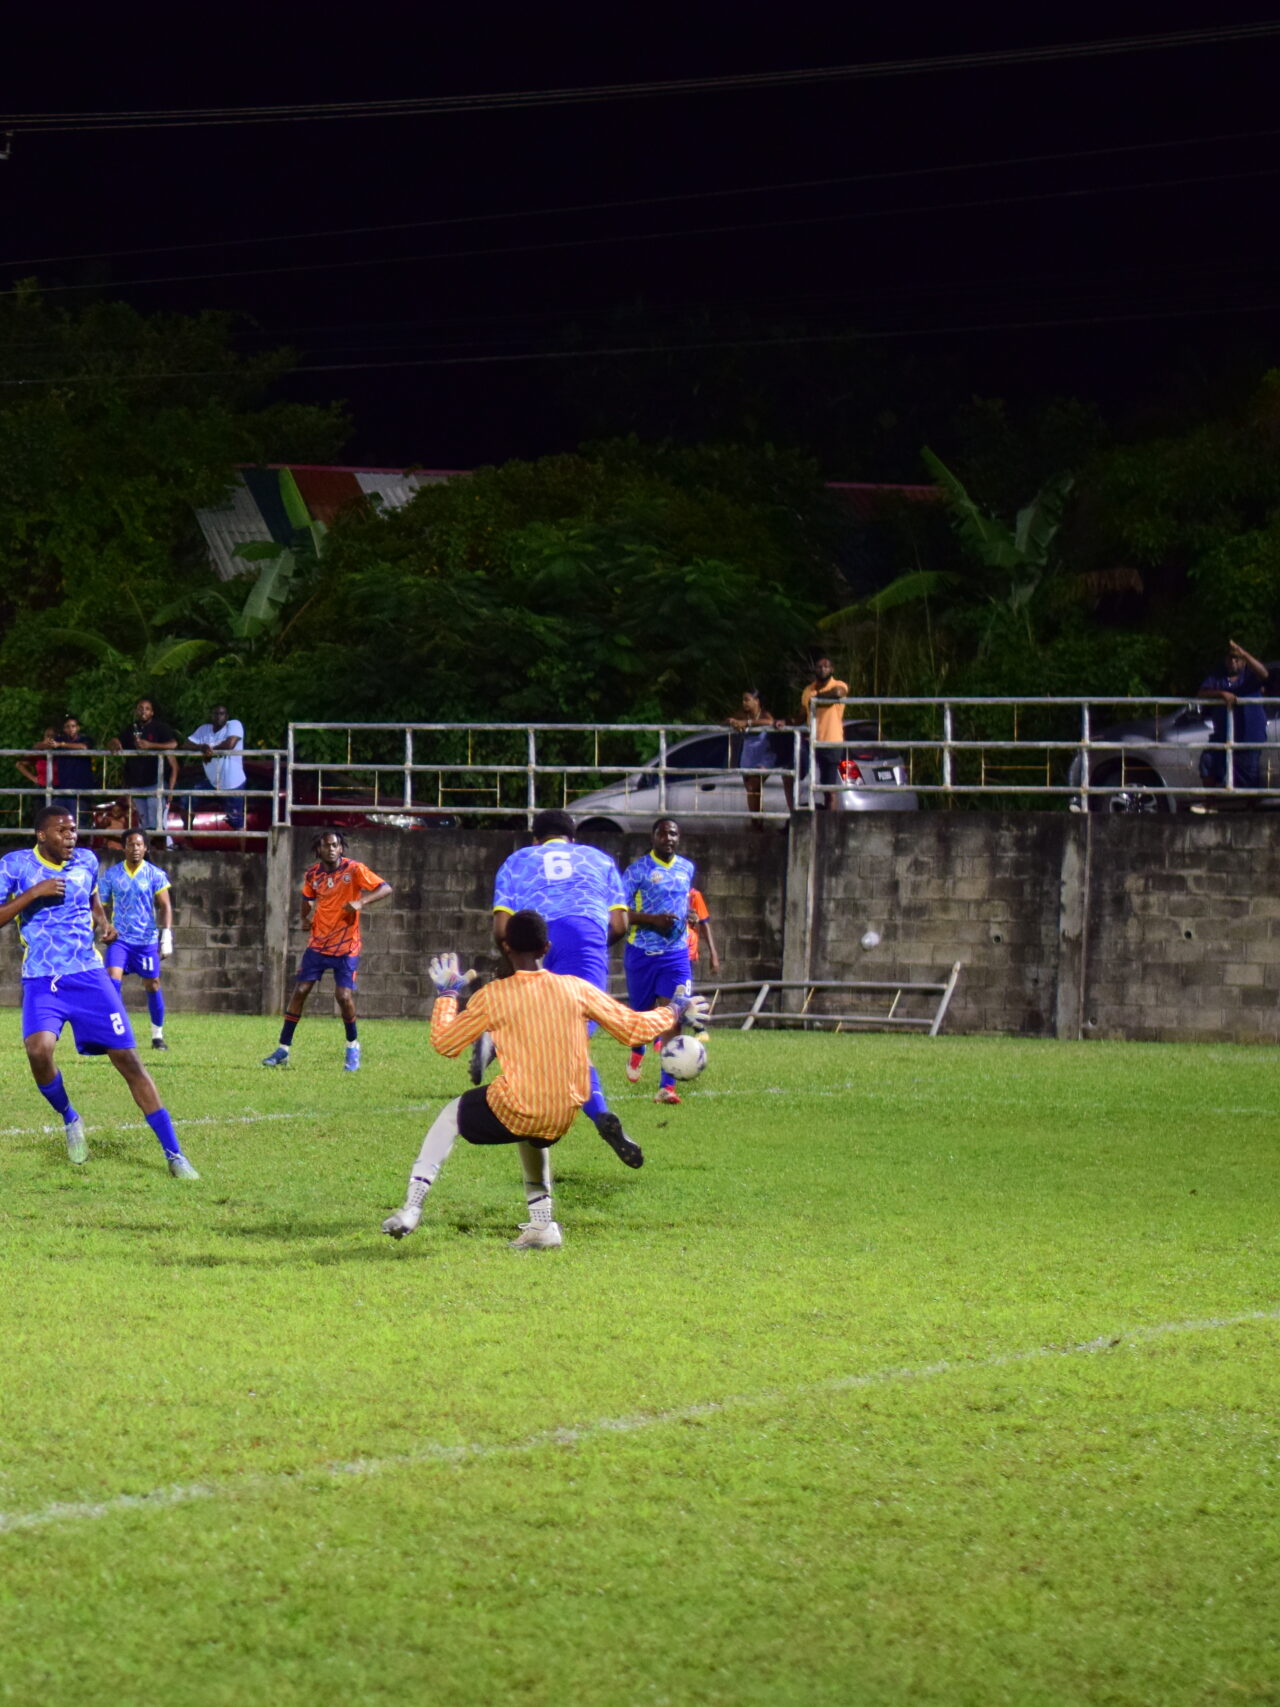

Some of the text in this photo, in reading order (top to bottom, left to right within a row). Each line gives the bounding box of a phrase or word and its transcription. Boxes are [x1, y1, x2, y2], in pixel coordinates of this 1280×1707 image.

[543, 851, 572, 881] 6
[142, 956, 154, 971] 11
[110, 1012, 125, 1036] 5
